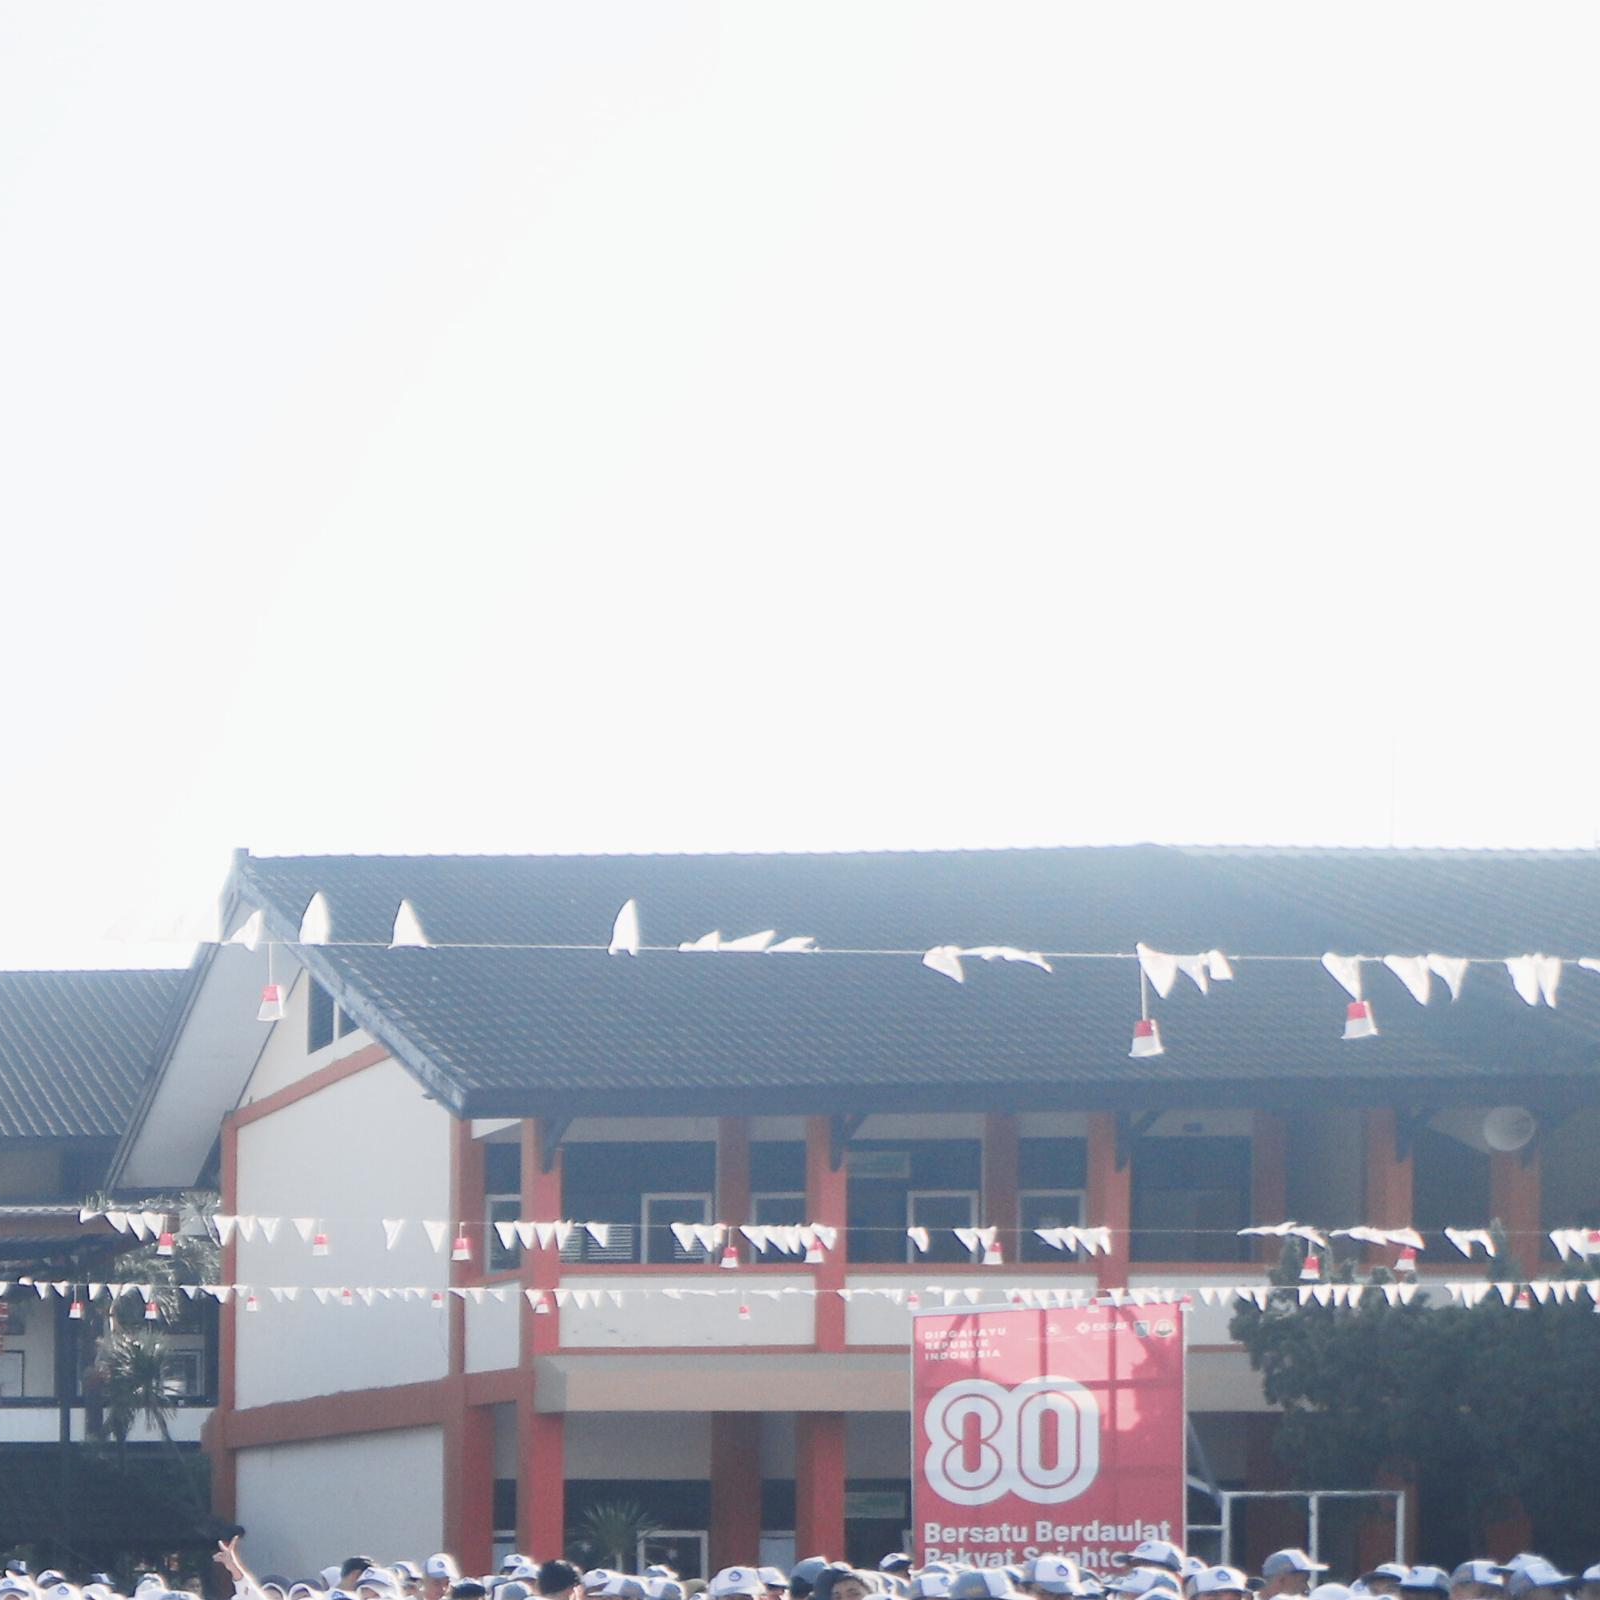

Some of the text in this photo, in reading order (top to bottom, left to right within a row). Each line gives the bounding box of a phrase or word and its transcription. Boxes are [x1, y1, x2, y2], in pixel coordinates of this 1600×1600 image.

[924, 1327, 1006, 1339] DIRGAHAYU
[924, 1339, 989, 1350] REPUBLIK
[924, 1349, 1001, 1360] INDONESIA
[923, 1374, 1100, 1506] 80
[924, 1519, 1171, 1543] Bersatu Berdaulat
